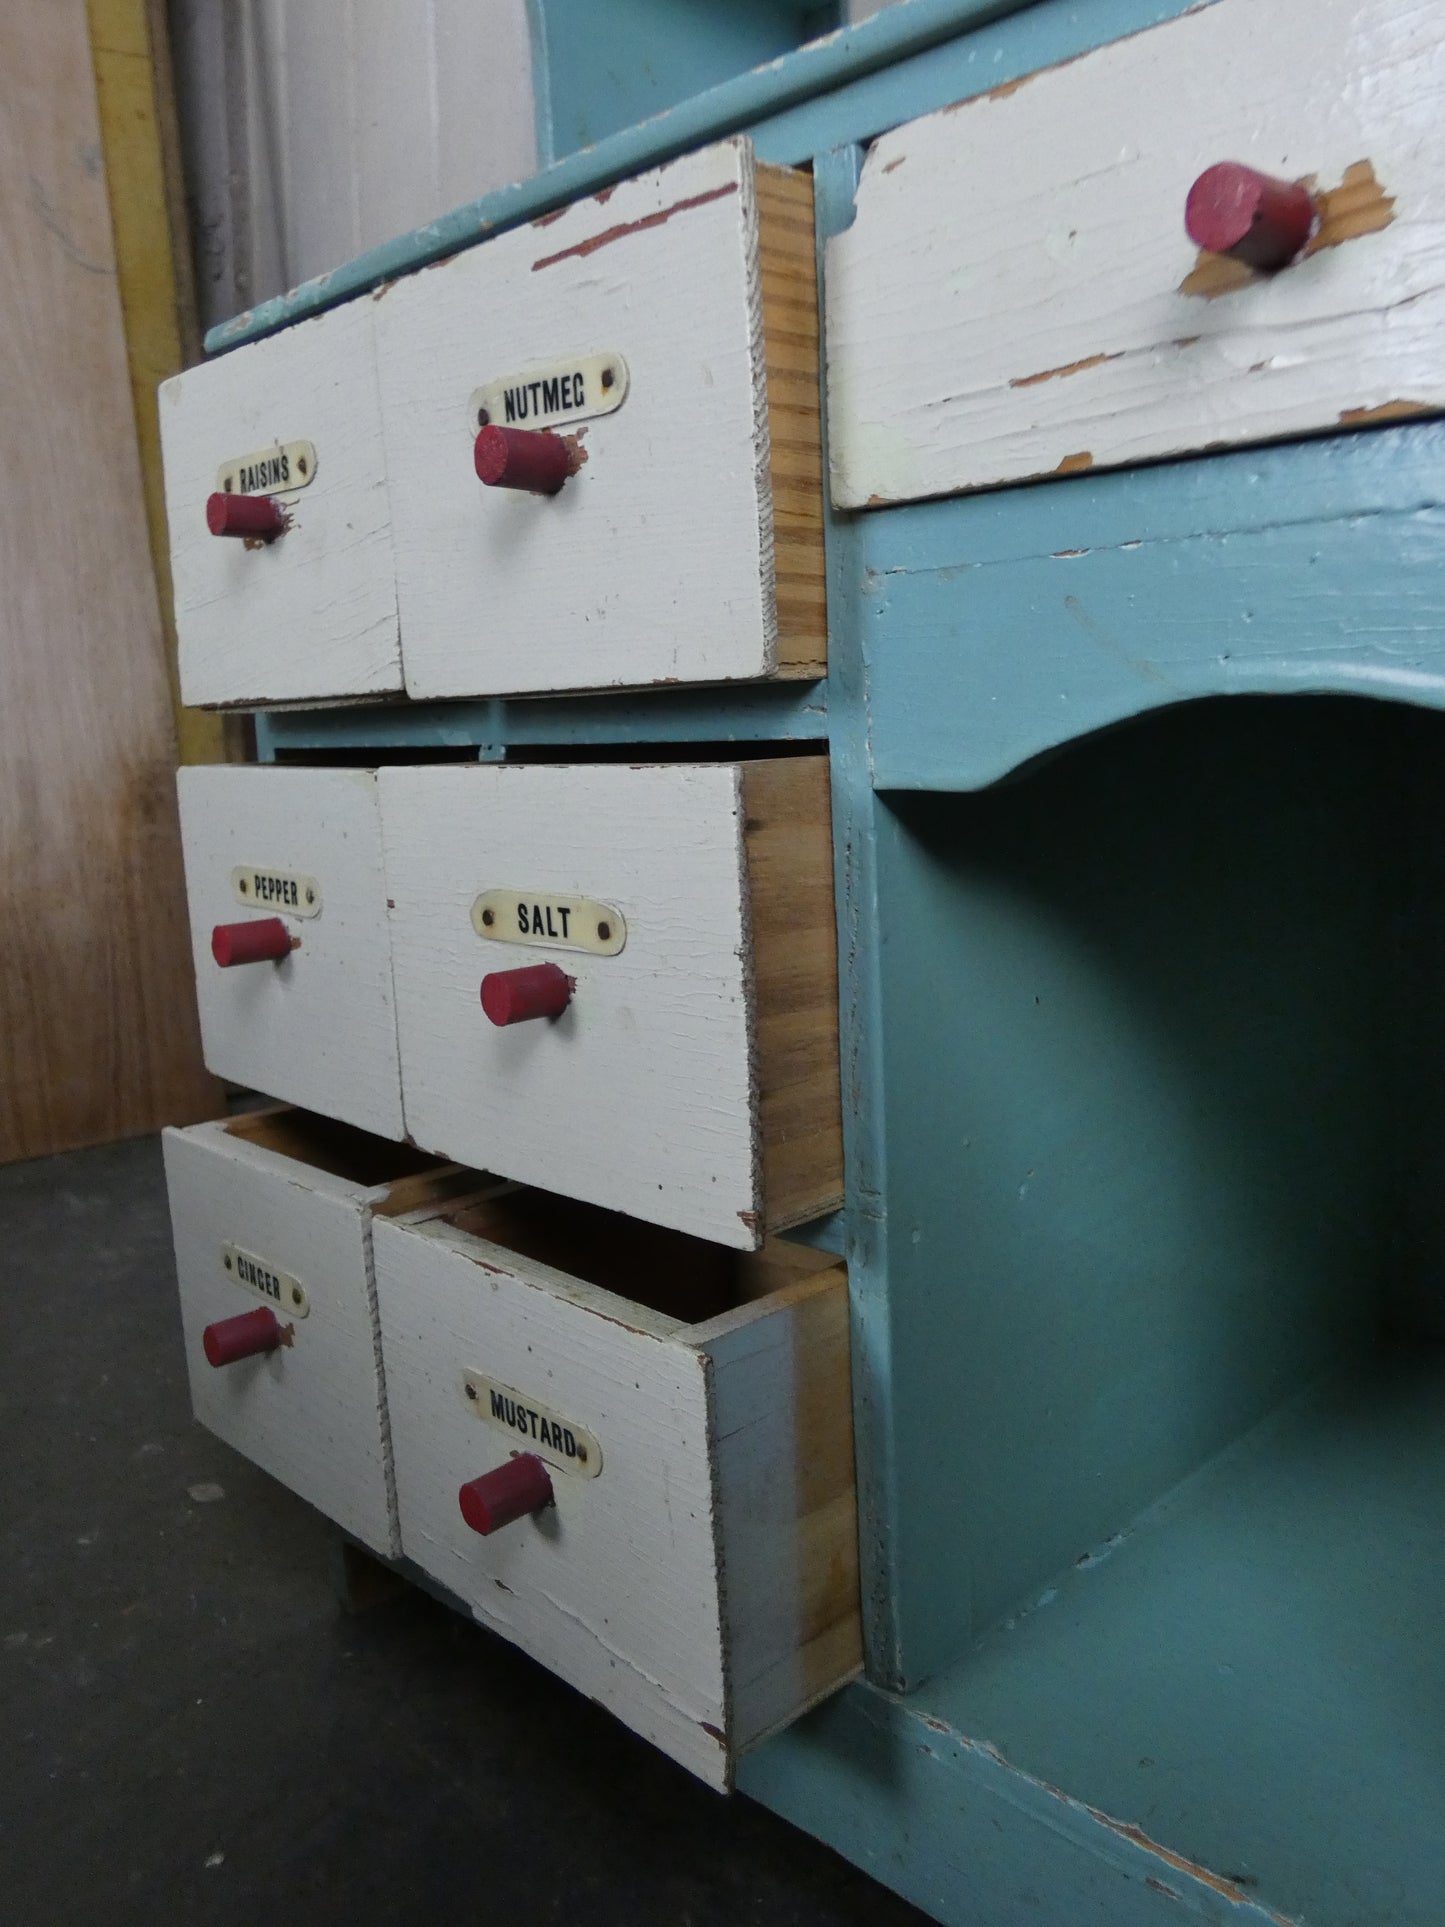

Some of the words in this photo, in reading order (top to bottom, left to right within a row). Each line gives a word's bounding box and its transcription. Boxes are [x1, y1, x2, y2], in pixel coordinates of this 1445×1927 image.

[504, 372, 584, 424] NUTMEG
[240, 455, 288, 493] RAISINS
[254, 875, 297, 905] PEPPER
[517, 903, 570, 937] SALT
[237, 1257, 280, 1300] GINGER
[490, 1390, 576, 1457] MUSTARD
